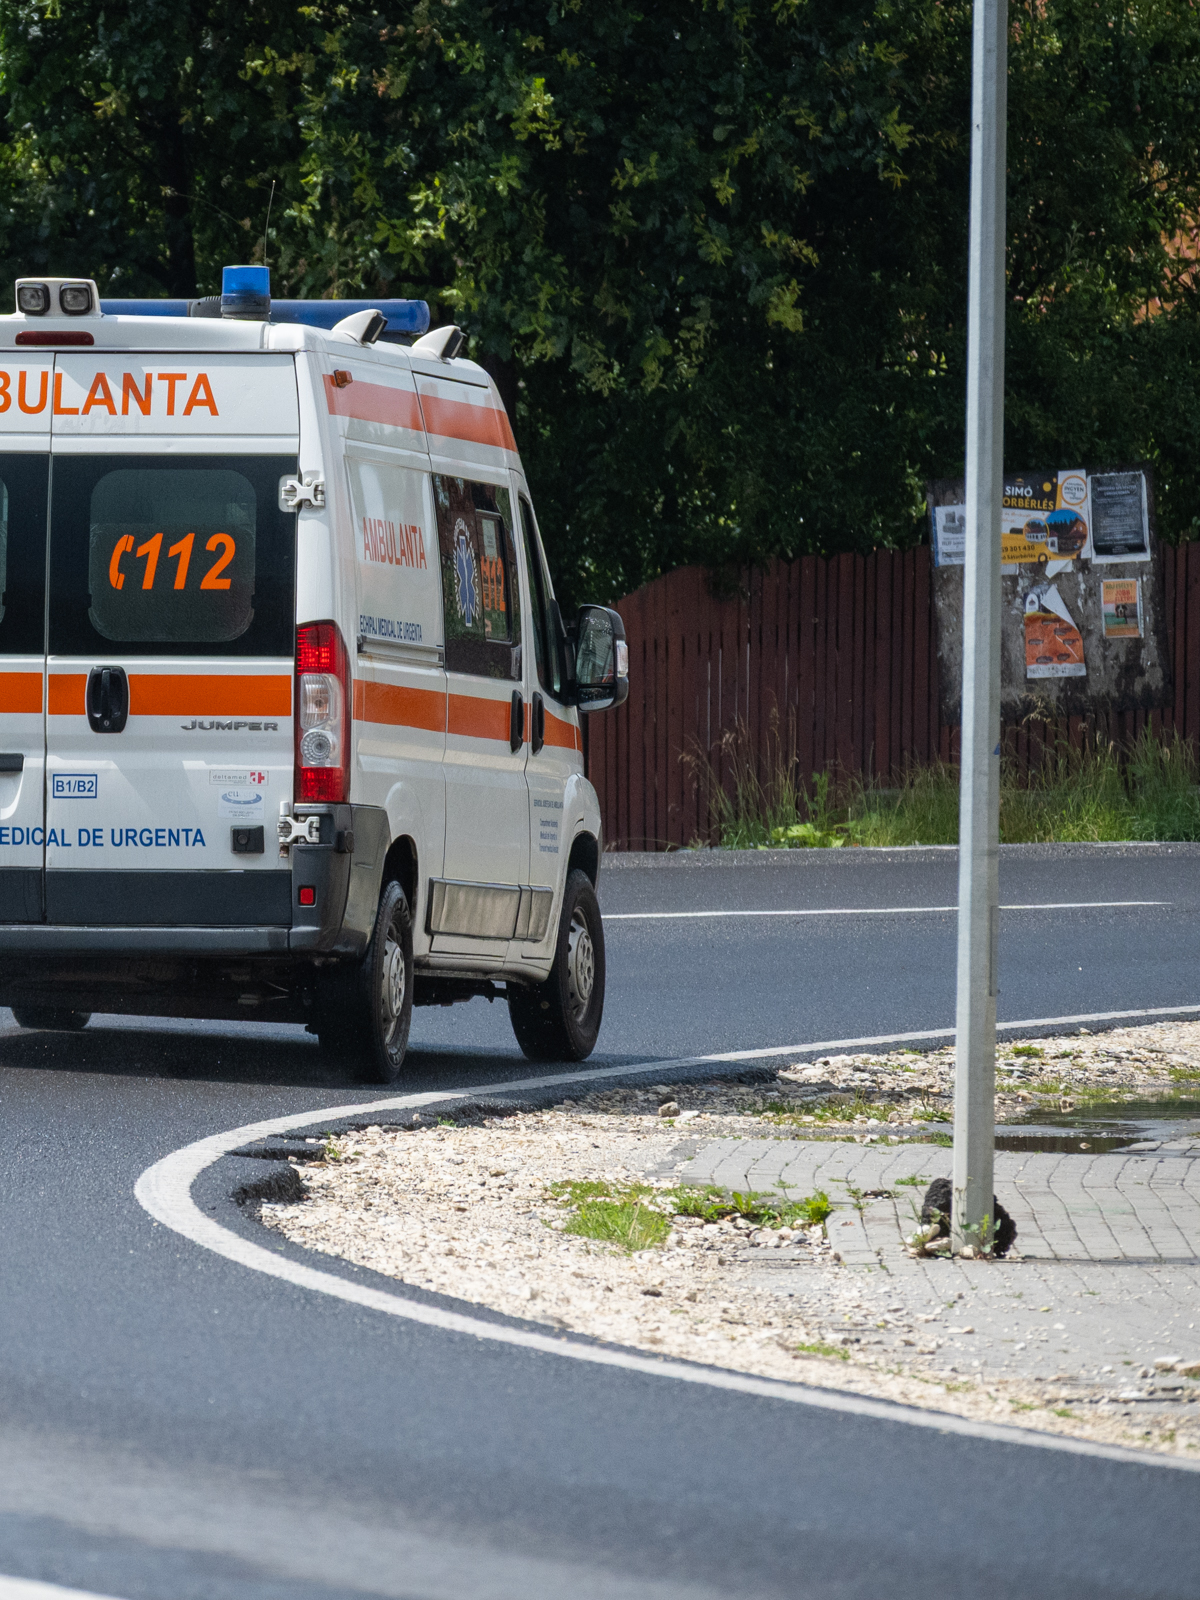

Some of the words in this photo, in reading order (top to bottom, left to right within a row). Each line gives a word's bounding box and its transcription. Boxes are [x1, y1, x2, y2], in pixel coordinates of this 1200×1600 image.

[1005, 484, 1033, 497] SIMÓ
[363, 516, 428, 570] AMBULANTA
[136, 532, 236, 590] 112
[180, 719, 278, 731] JUMPER
[56, 780, 94, 792] B1/B2
[78, 828, 104, 847] DE
[110, 828, 206, 847] URGENTA
